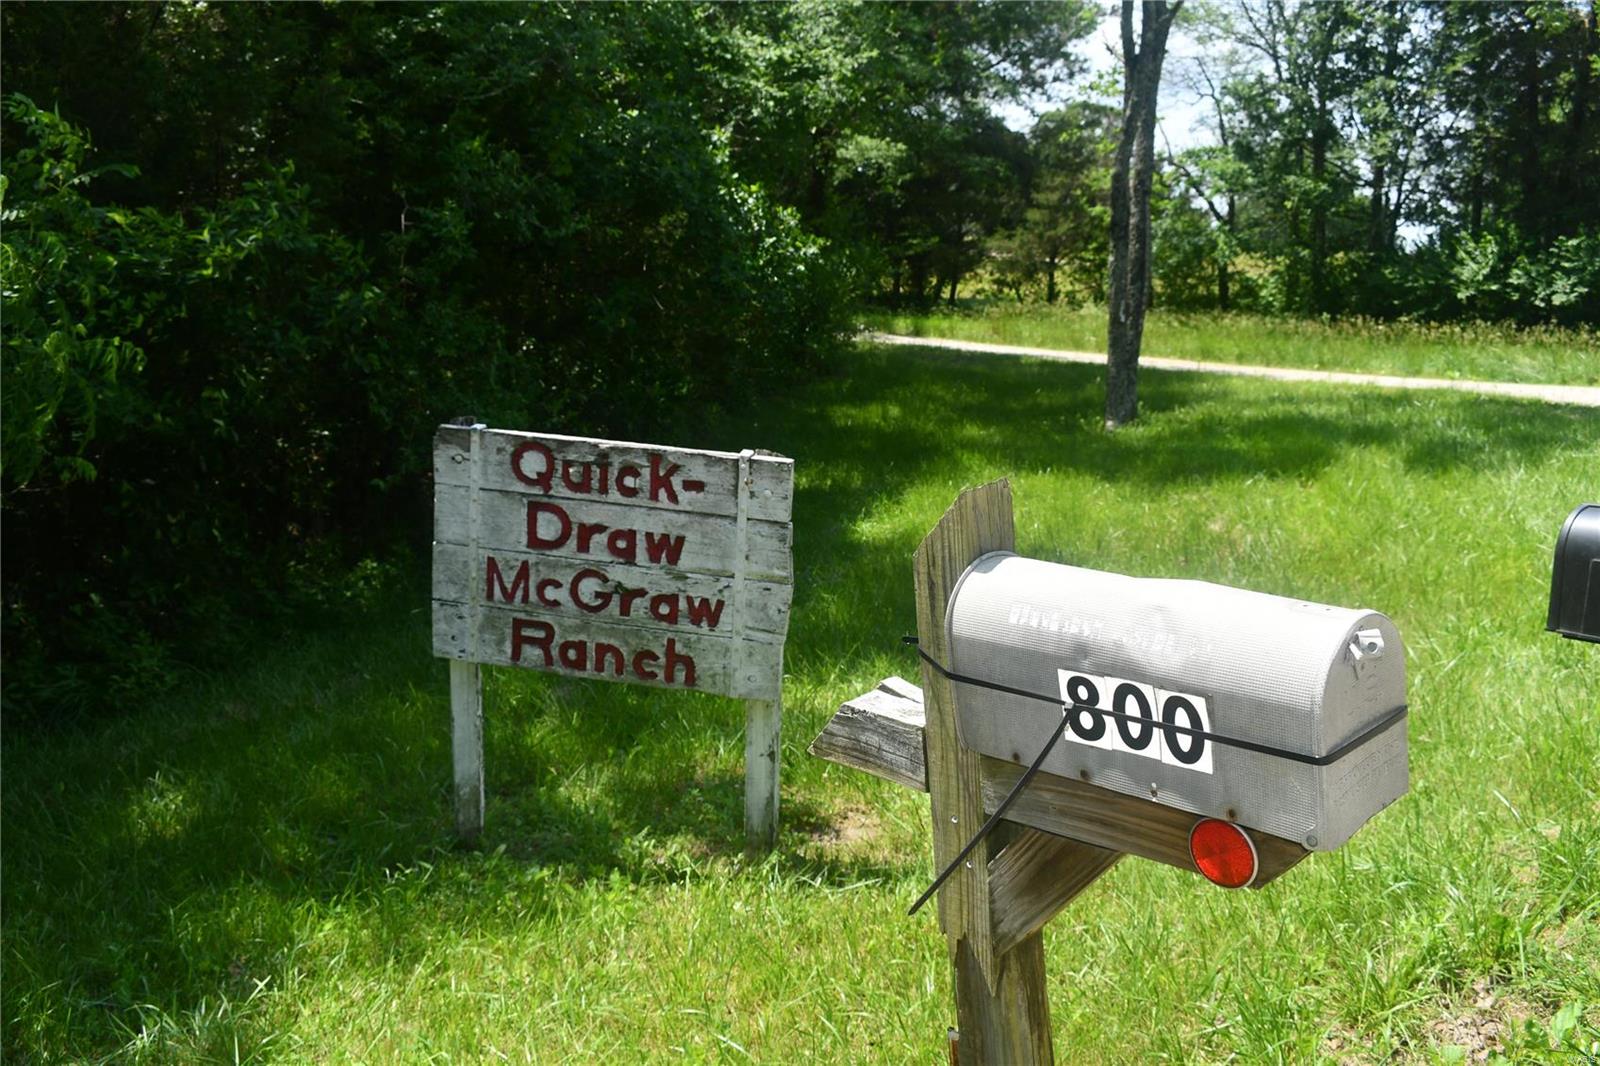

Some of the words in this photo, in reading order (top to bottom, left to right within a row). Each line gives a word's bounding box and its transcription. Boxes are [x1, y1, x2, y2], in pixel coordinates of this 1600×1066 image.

[511, 441, 705, 504] Quick-
[526, 500, 686, 566] Draw
[486, 556, 725, 628] McGraw
[511, 617, 697, 687] Ranch
[1067, 676, 1205, 765] 800
